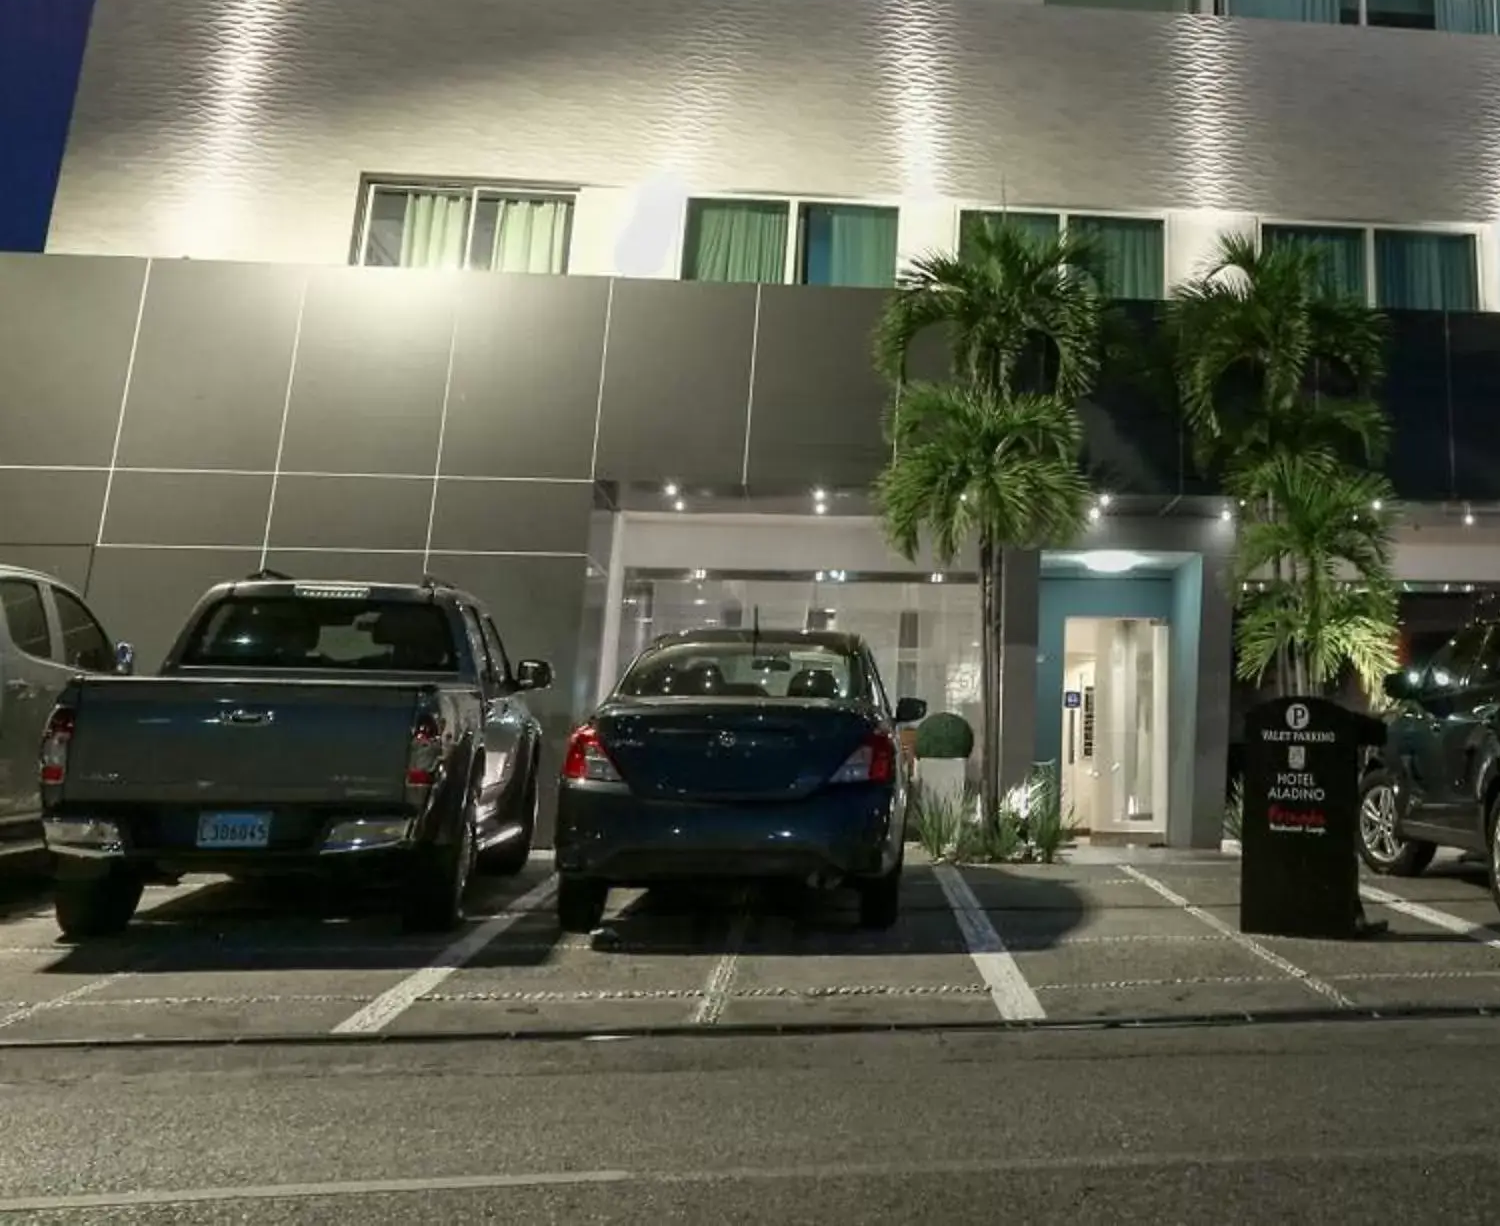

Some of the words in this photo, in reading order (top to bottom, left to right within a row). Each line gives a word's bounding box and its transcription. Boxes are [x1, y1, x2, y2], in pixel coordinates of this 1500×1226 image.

[1261, 729, 1290, 741] VALET
[1292, 730, 1335, 743] PARKING
[1277, 773, 1315, 786] HOTEL
[1268, 787, 1325, 801] ALADINO
